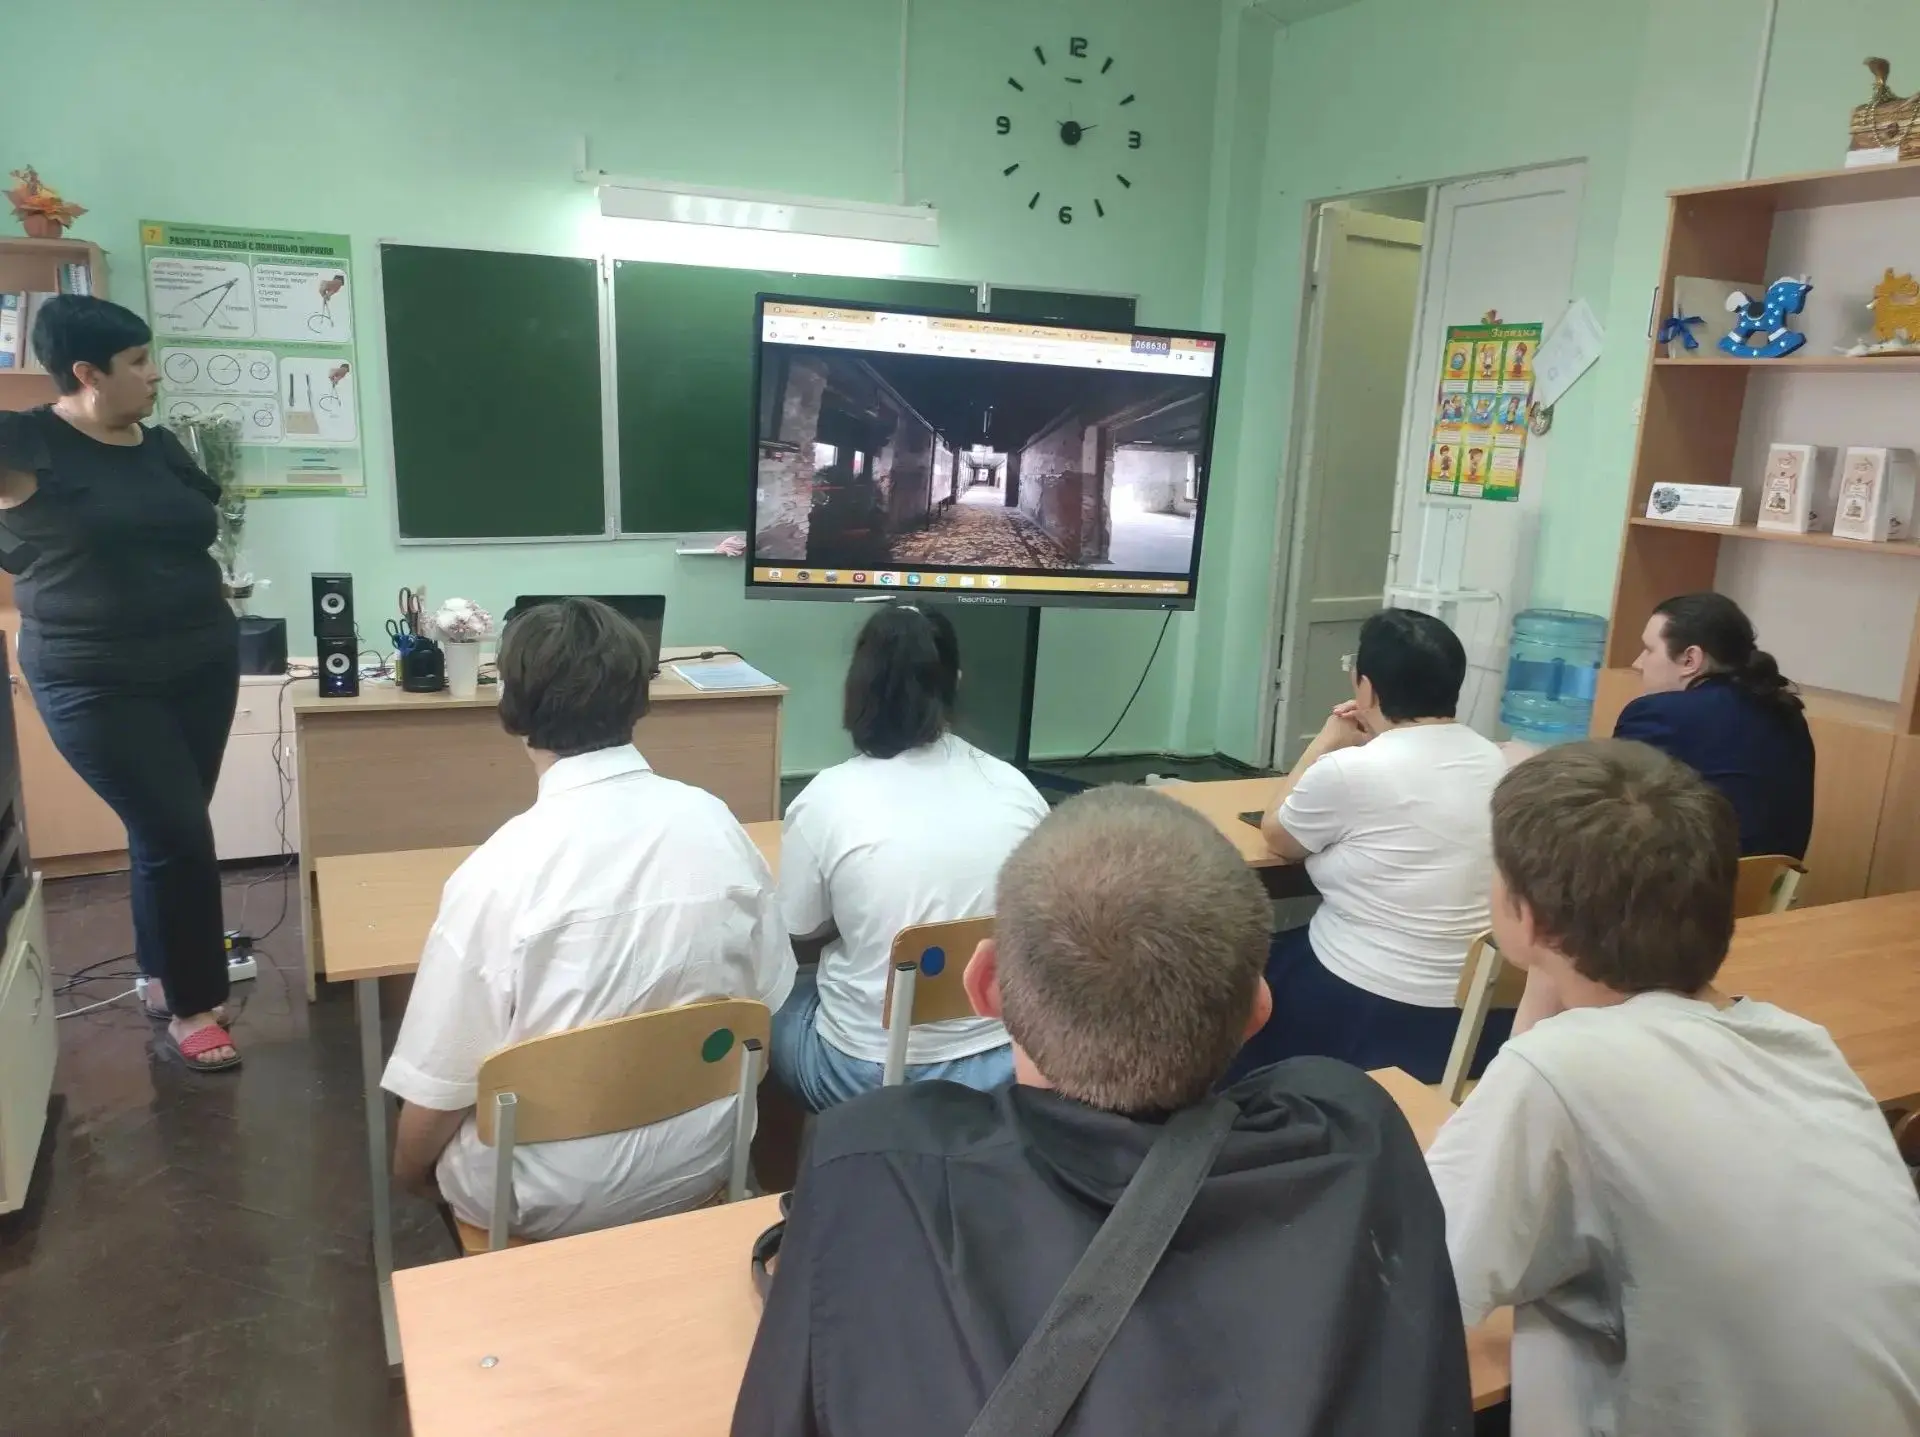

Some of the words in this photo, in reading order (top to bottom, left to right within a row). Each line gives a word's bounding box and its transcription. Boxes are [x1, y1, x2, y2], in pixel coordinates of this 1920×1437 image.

[1069, 36, 1089, 58] 12
[995, 115, 1011, 135] 9
[1128, 130, 1142, 149] 3
[1058, 206, 1073, 225] 6
[148, 229, 157, 240] 7
[169, 235, 211, 247] РАЗМЕТКА
[213, 238, 247, 250] ДЕТАЛЕЙ
[248, 242, 254, 251] С
[255, 242, 298, 254] ПОМОЩЬЮ
[1135, 340, 1167, 351] 068630
[957, 595, 1007, 604] TeachTouch
